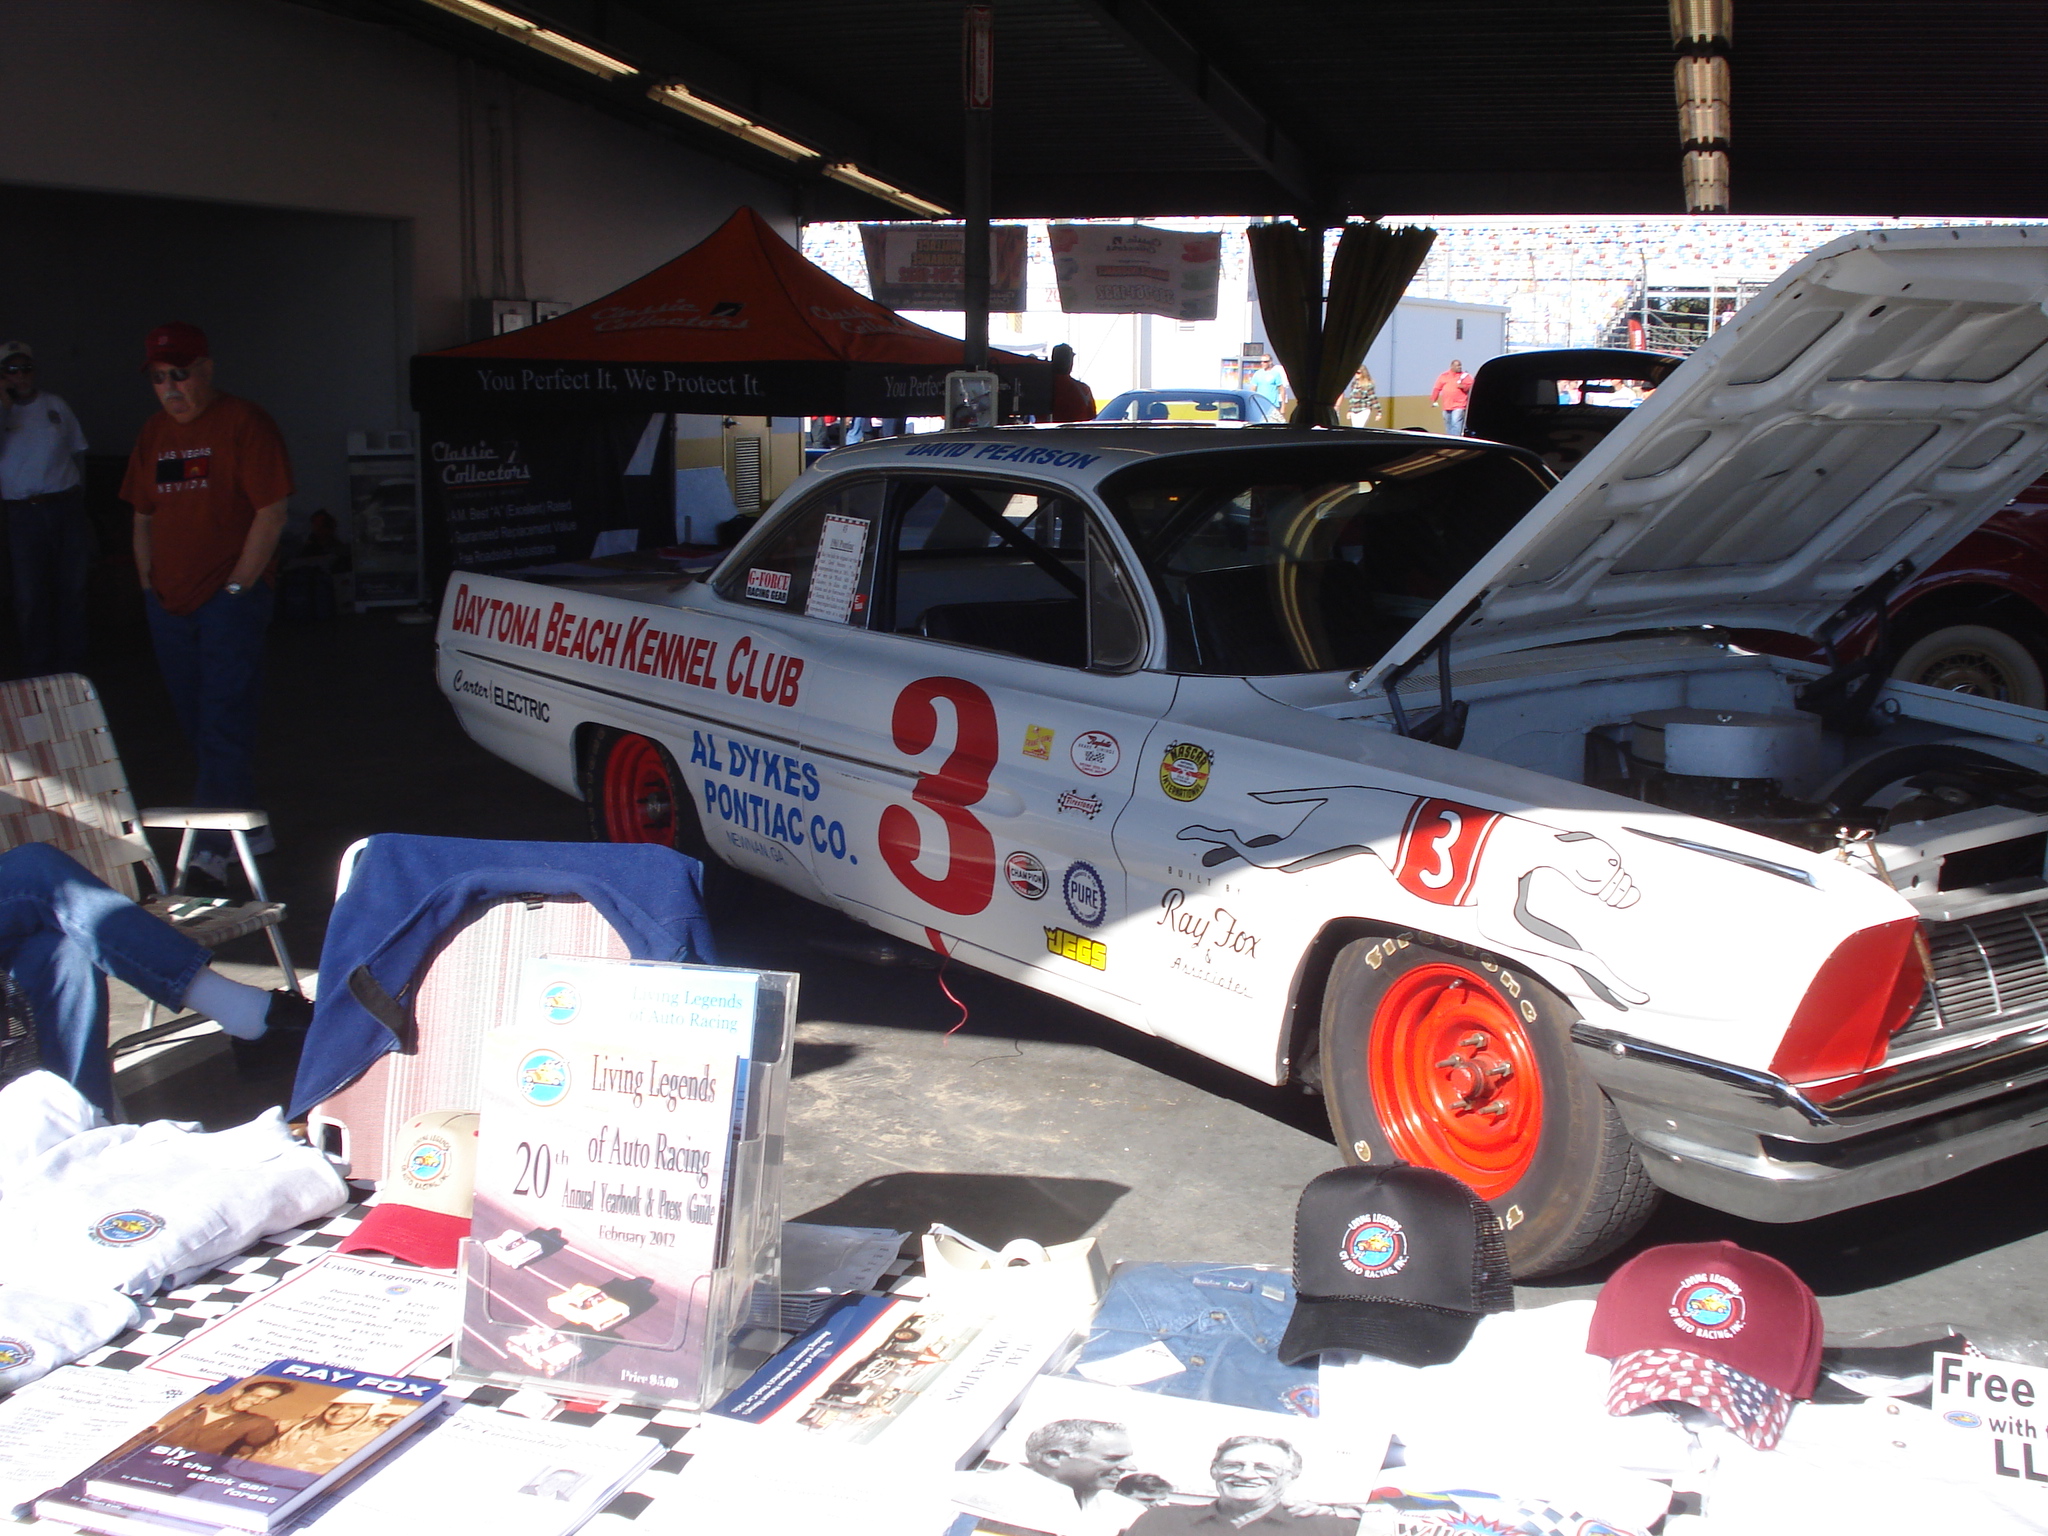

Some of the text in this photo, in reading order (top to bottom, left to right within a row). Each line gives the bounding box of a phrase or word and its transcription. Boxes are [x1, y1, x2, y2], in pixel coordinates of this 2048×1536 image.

[592, 299, 701, 321] Classic
[595, 314, 749, 334] Collectors
[477, 369, 516, 391] You
[521, 366, 591, 391] Perfect
[597, 368, 617, 392] It,
[624, 368, 656, 391] We
[663, 370, 726, 395] Protect
[883, 374, 946, 397] You Perfec
[158, 447, 213, 461] LAS VEGAS
[431, 440, 499, 462] Classic
[905, 442, 1102, 471] DAVID PEARSON
[442, 463, 531, 485] Collectors
[747, 570, 791, 591] G-FORCE
[746, 586, 787, 602] RACING GEAR
[451, 583, 805, 708] DAYTONA BEACH KENNEL CLUB
[453, 669, 551, 723] Carter ELECTRIC
[690, 730, 820, 801] AL DYKES
[1170, 746, 1208, 770] NASCAR
[878, 675, 999, 916] 3
[1065, 795, 1094, 812] Firestone
[704, 778, 858, 865] PONTIAC CO.
[1418, 809, 1462, 889] 3
[1010, 868, 1042, 884] CHAMPION
[1168, 865, 1212, 886] BUILT
[1071, 880, 1098, 910] PURE
[1156, 887, 1261, 959] Ray Fox
[1045, 926, 1107, 971] JEGS
[684, 989, 743, 1011] Legends
[650, 1010, 684, 1026] Auto
[689, 1012, 739, 1034] Racing
[591, 1054, 717, 1113] Living Legends
[587, 1125, 712, 1189] of Auto Racing
[512, 1141, 552, 1200] 20
[561, 1179, 716, 1226] Annual Yearbook & Press Guide
[1372, 1213, 1403, 1232] LEGENDS
[598, 1224, 676, 1248] February 2012
[322, 1261, 430, 1286] Living Legends
[1342, 1259, 1364, 1275] AUTO
[1709, 1273, 1743, 1295] LEGENDS
[1673, 1316, 1696, 1334] AUTO
[281, 1362, 433, 1398] RAY FOX
[621, 1369, 648, 1385] Price
[1940, 1356, 2036, 1408] Free
[1988, 1415, 2038, 1440] with
[182, 1461, 213, 1473] the
